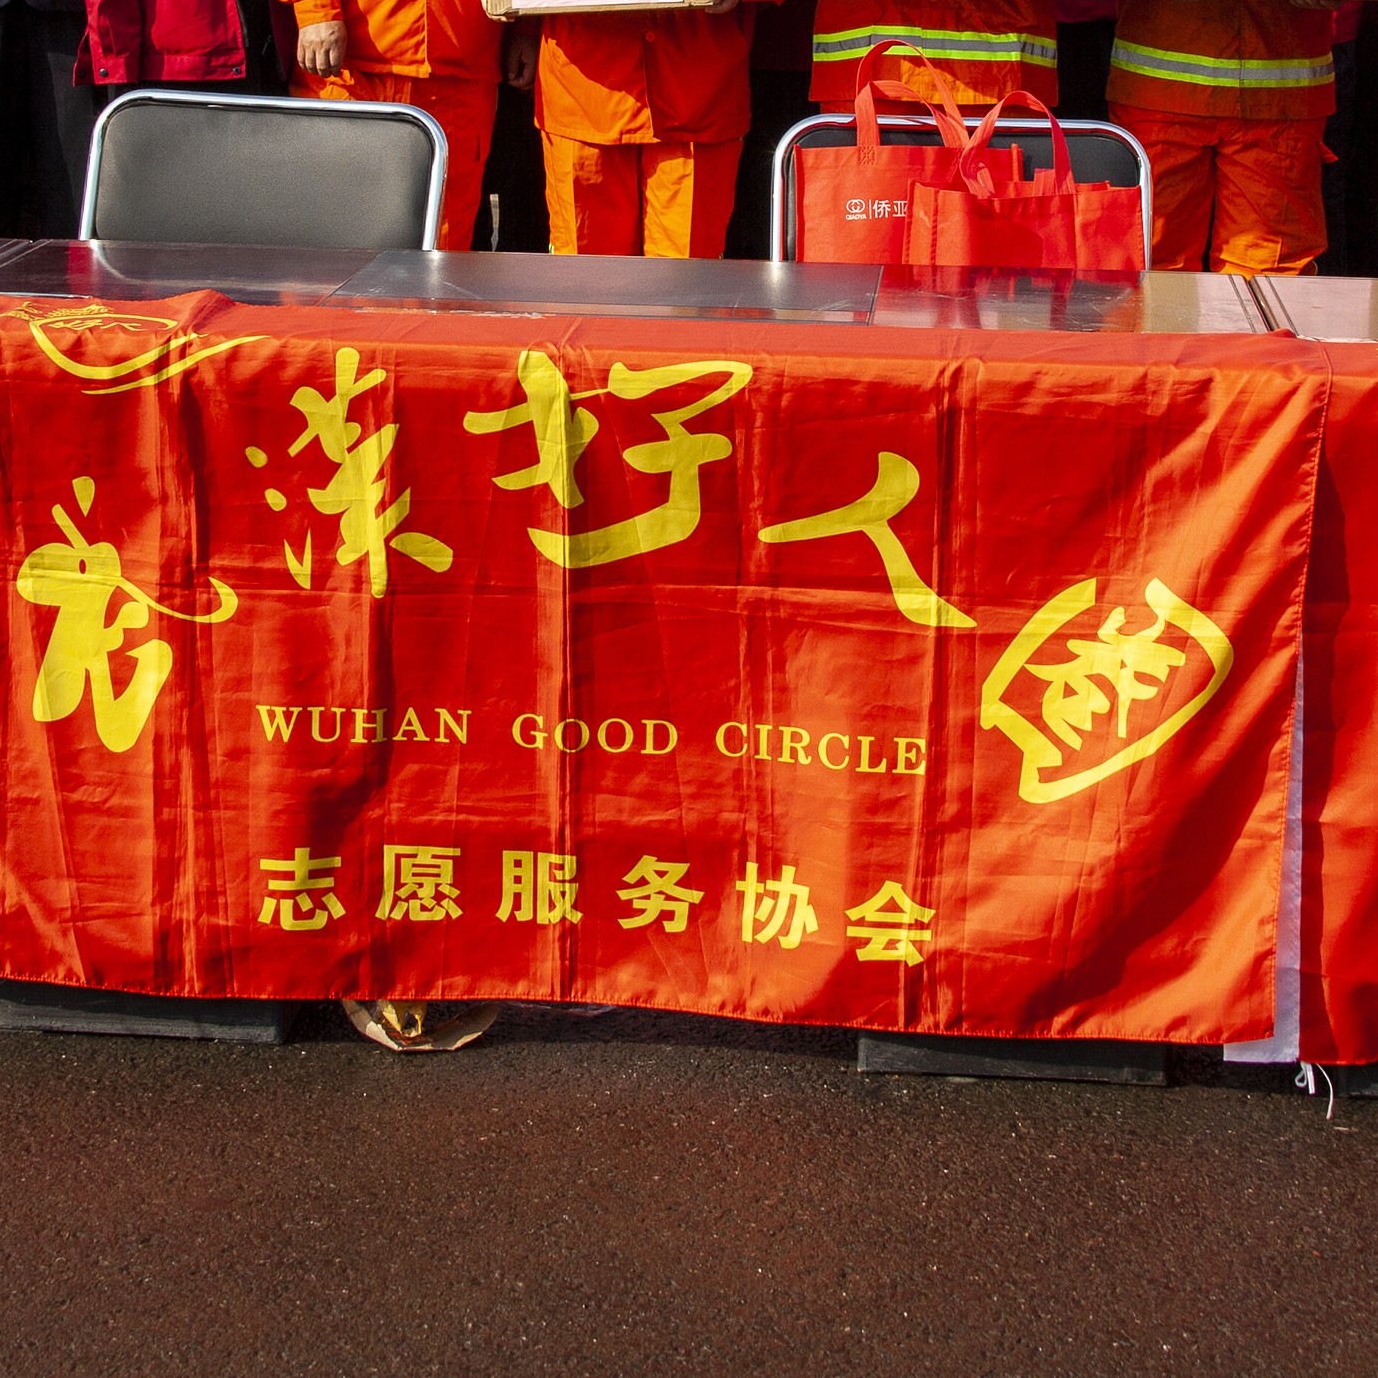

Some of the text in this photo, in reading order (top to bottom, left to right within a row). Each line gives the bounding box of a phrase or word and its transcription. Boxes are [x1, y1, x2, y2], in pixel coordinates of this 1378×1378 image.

[872, 199, 908, 219] 侨亚
[255, 704, 929, 776] WUHAN GOOD CIRCLE
[258, 843, 937, 967] 志愿服务协会
